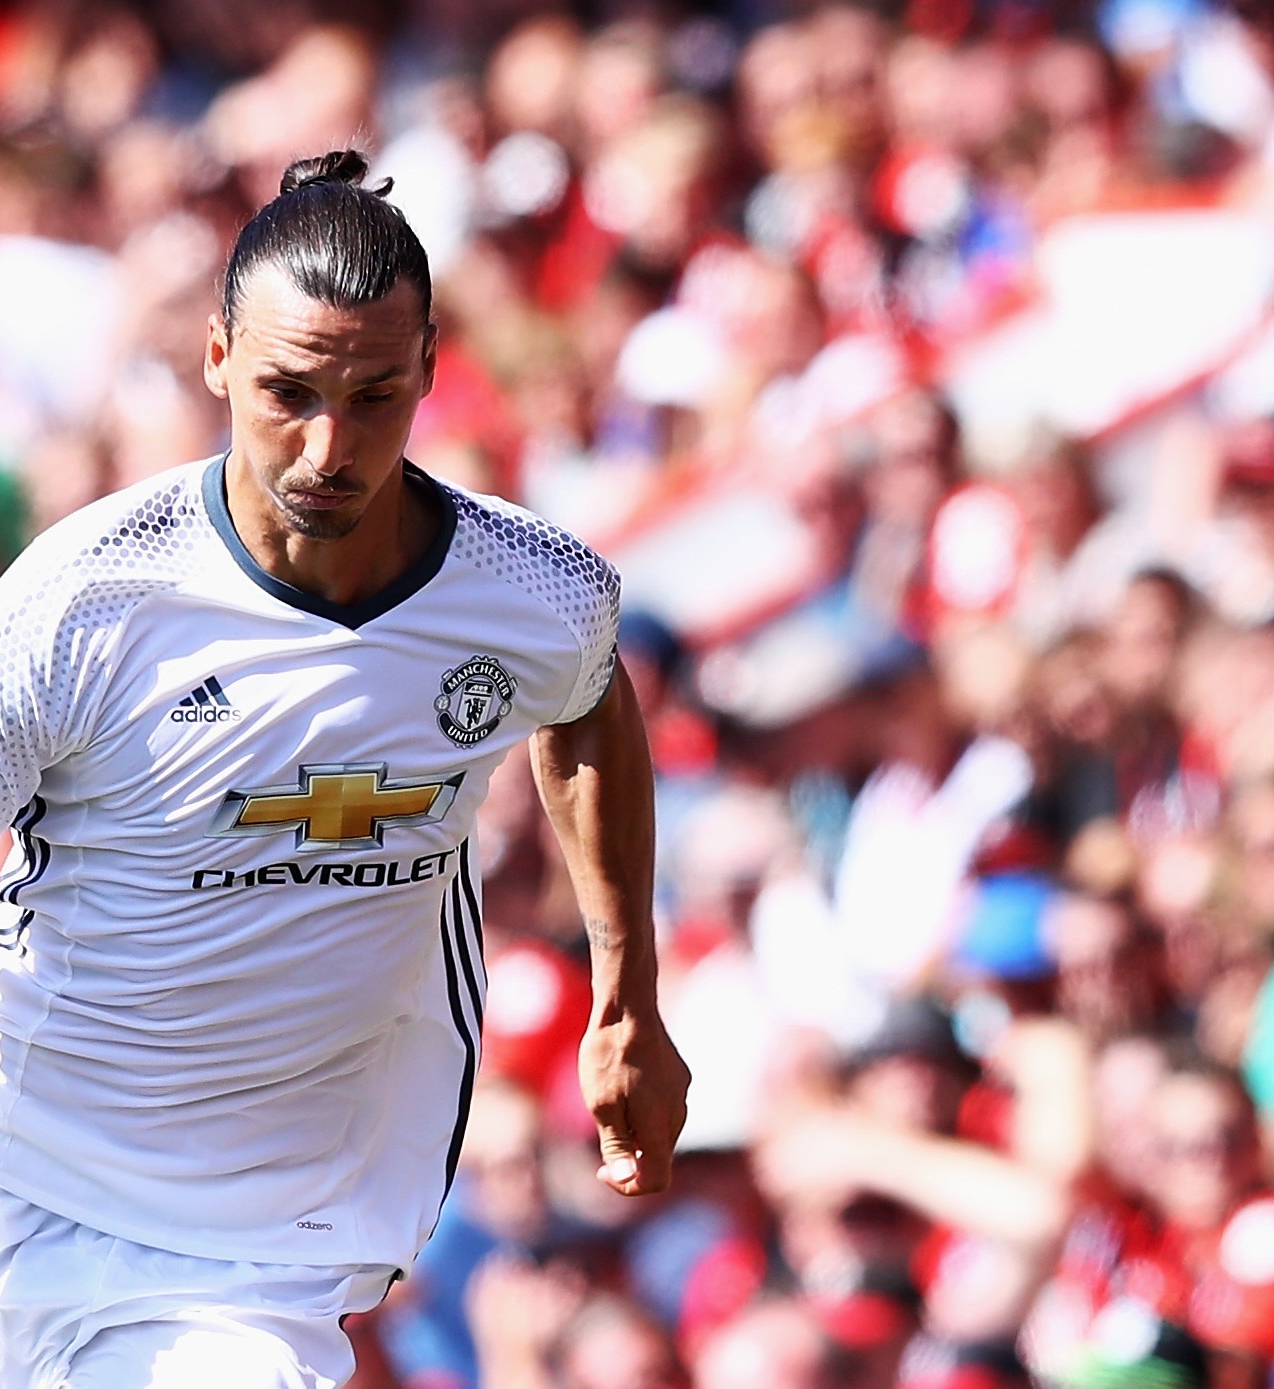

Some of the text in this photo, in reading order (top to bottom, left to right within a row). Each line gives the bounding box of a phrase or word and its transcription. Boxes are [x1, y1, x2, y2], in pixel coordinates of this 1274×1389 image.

[447, 663, 510, 697] MANCHESTER
[170, 705, 242, 723] adidas
[447, 725, 489, 742] UNITED
[192, 849, 456, 889] CHEVROLET
